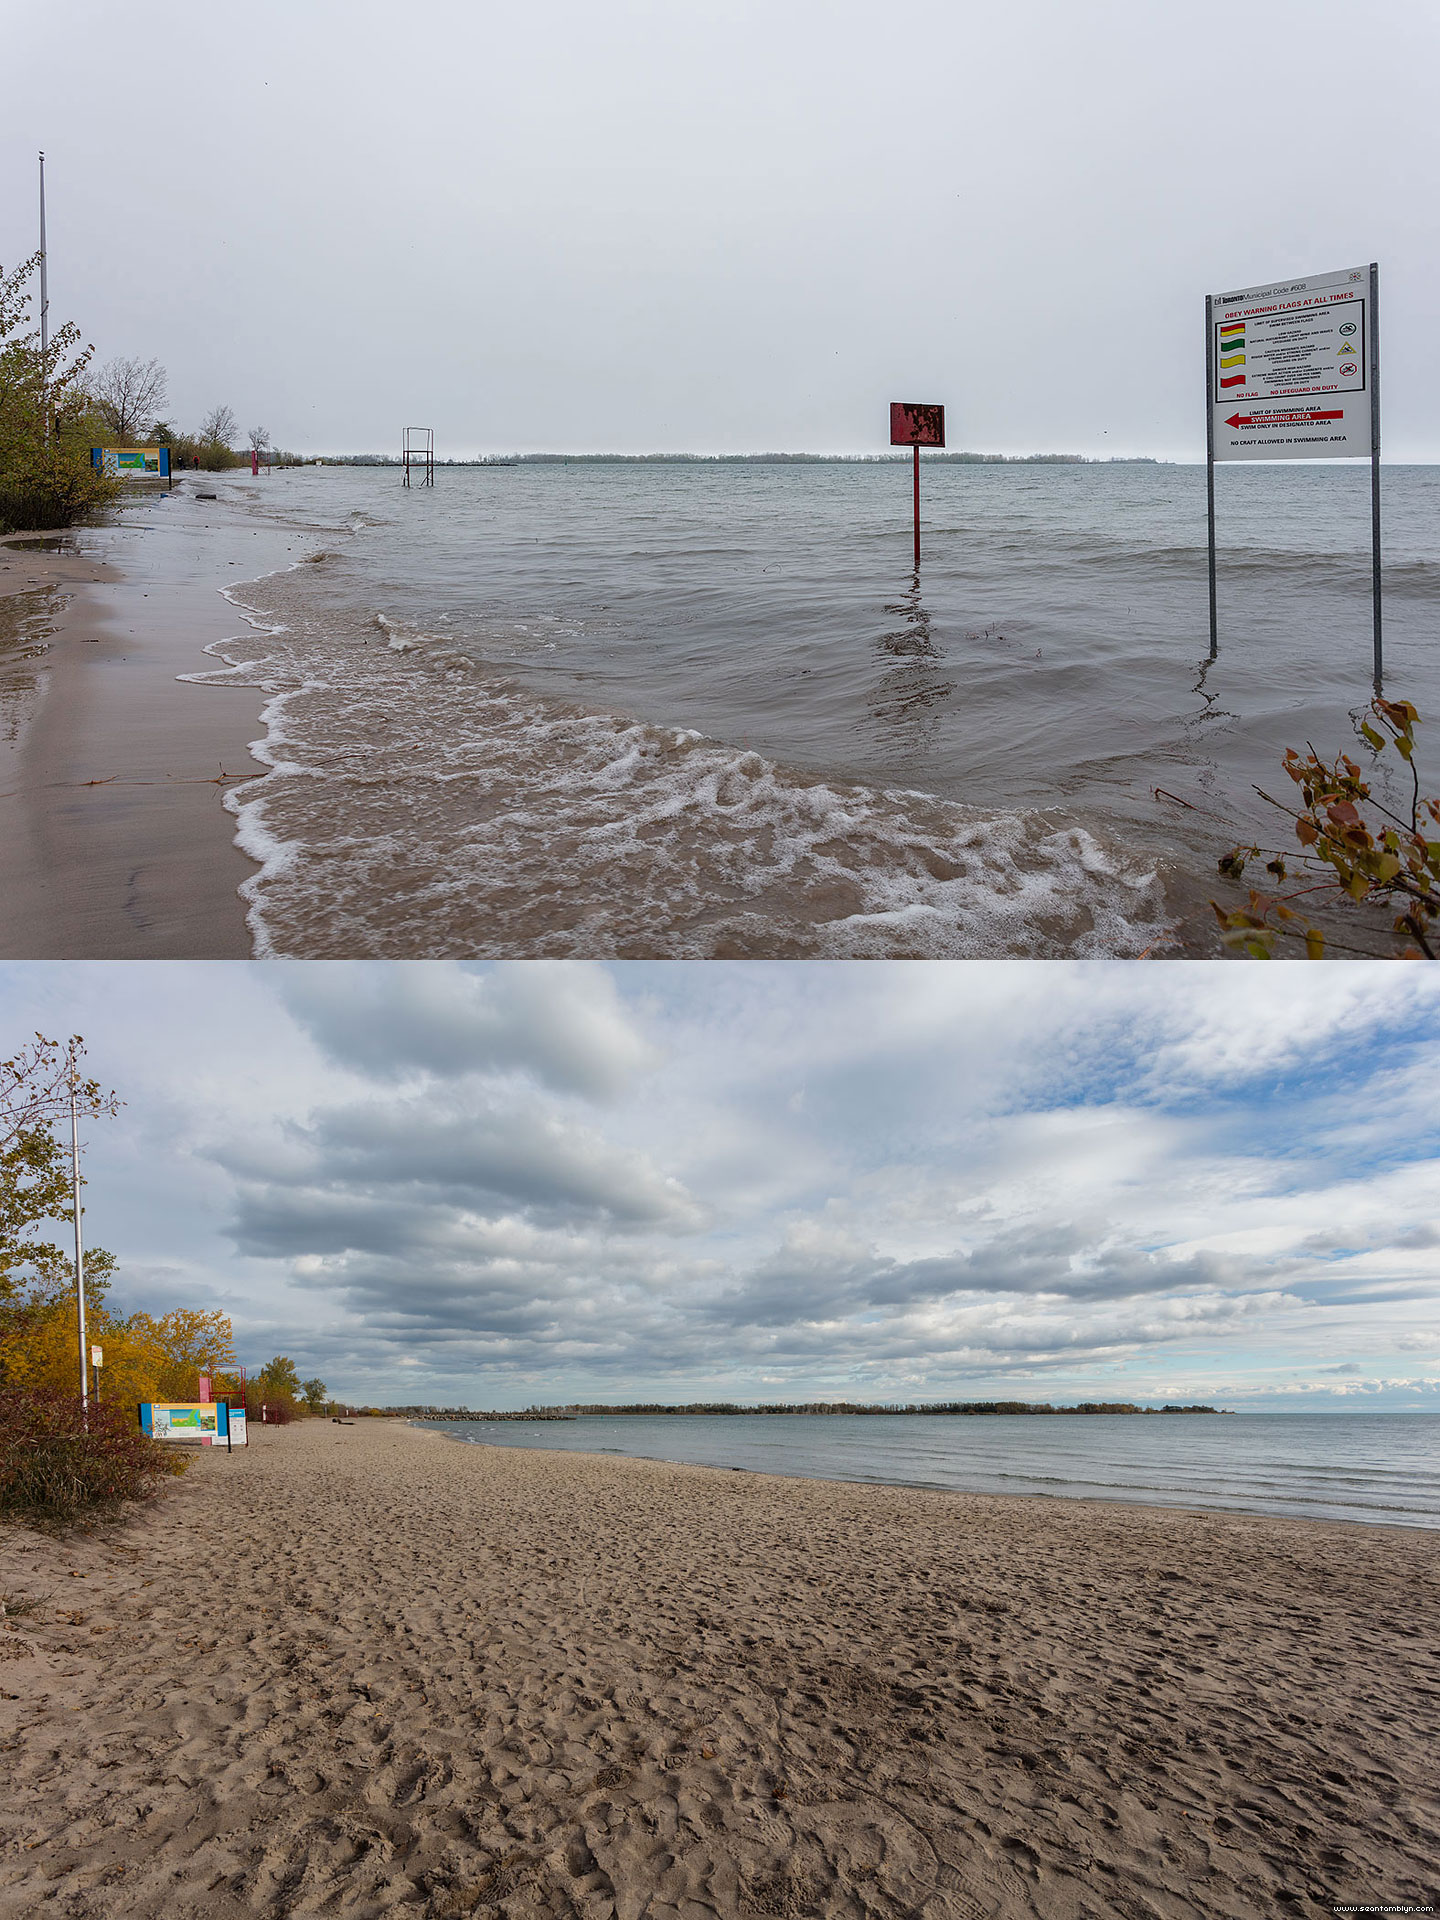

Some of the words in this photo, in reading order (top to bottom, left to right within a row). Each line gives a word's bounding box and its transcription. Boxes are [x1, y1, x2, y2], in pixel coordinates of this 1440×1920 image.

[1244, 289, 1272, 300] Municipal
[1244, 305, 1277, 315] WARNING
[1279, 300, 1301, 309] FLAGS
[1330, 292, 1354, 301] TIMES
[1251, 415, 1290, 423] SWIMMING
